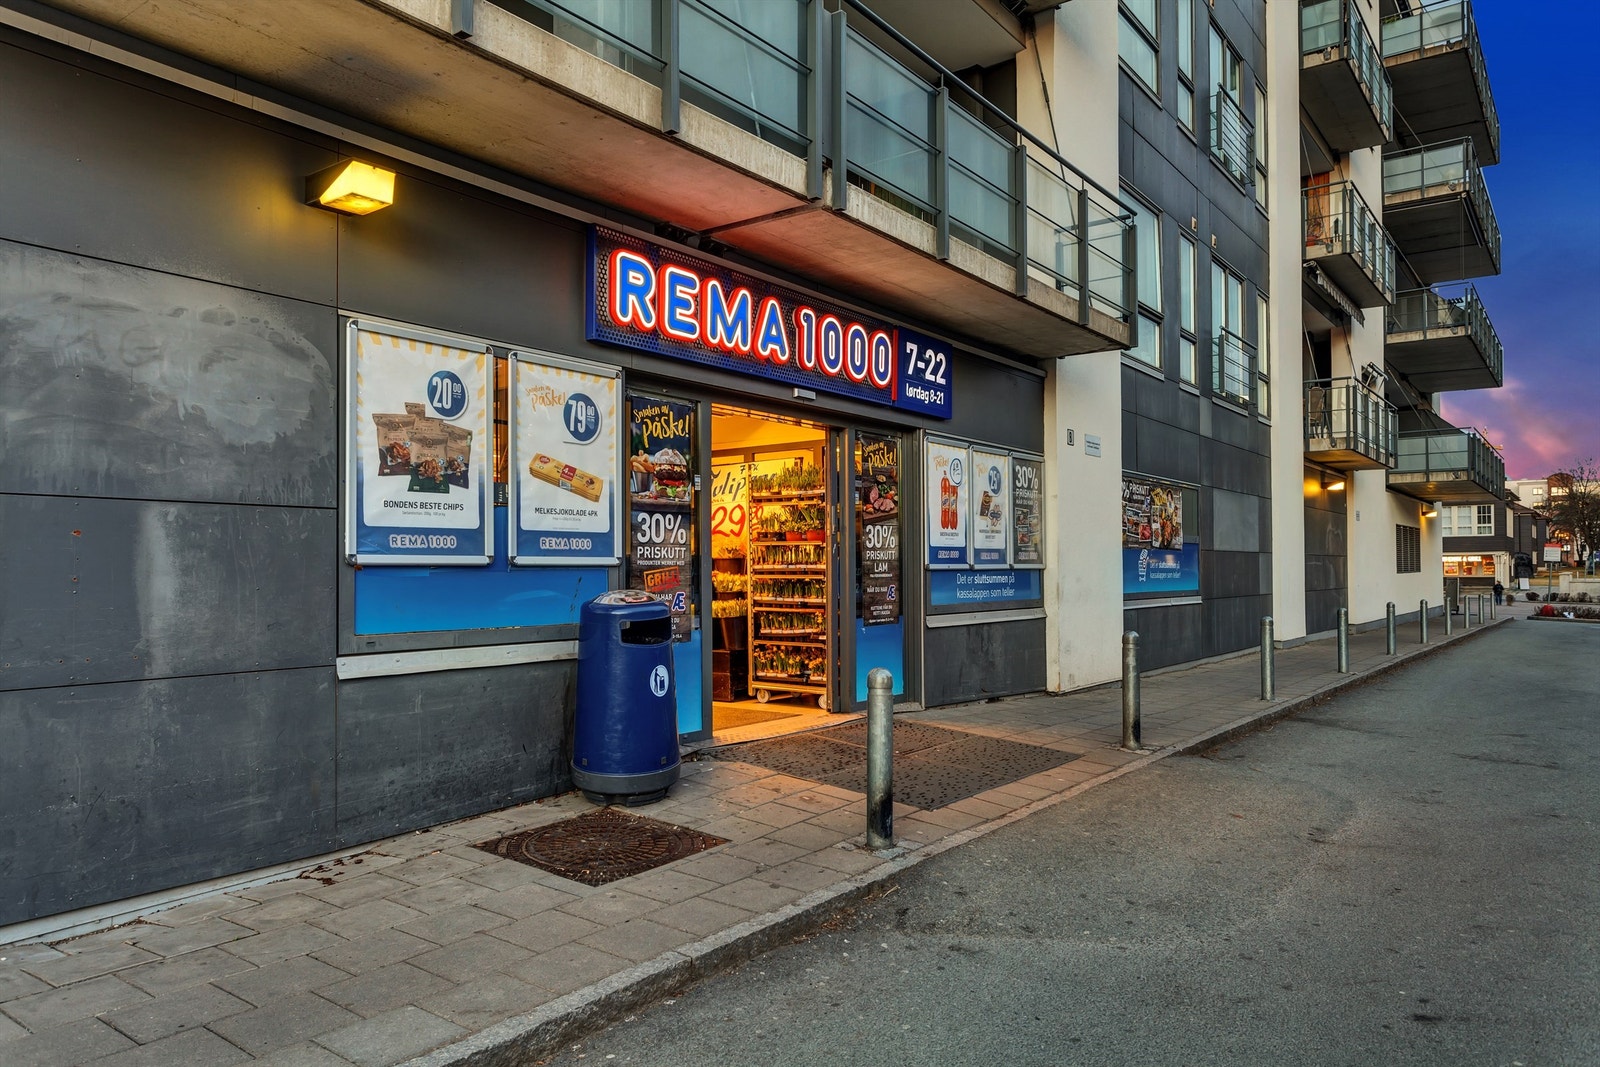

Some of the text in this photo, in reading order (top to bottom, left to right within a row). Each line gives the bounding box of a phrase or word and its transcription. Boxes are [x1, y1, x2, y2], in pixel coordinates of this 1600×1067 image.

[609, 249, 893, 389] REMA 1000
[906, 341, 946, 385] 7-22
[432, 376, 452, 409] 20
[906, 383, 944, 405] lørdag 8-21
[568, 400, 586, 433] 79
[633, 405, 669, 423] Smaken av
[642, 411, 689, 448] påske!
[868, 446, 897, 475] påske!
[1015, 465, 1038, 489] 30%
[383, 500, 464, 511] BONDENS BESTE CHIPS
[534, 507, 587, 516] MELKESJOKOLADE
[637, 512, 687, 544] 30%
[711, 504, 746, 537] 29
[390, 534, 457, 549] REMA 1000
[540, 537, 592, 550] REMA 1000
[866, 525, 895, 548] 30%
[637, 546, 687, 559] PRISKUTT
[866, 550, 895, 560] PRISKUTT
[874, 562, 888, 572] LAM
[957, 573, 966, 584] Det
[974, 573, 1008, 584] sluttsummen
[1008, 572, 1015, 585] på
[671, 591, 686, 611] Æ
[956, 587, 989, 600] kassalappen
